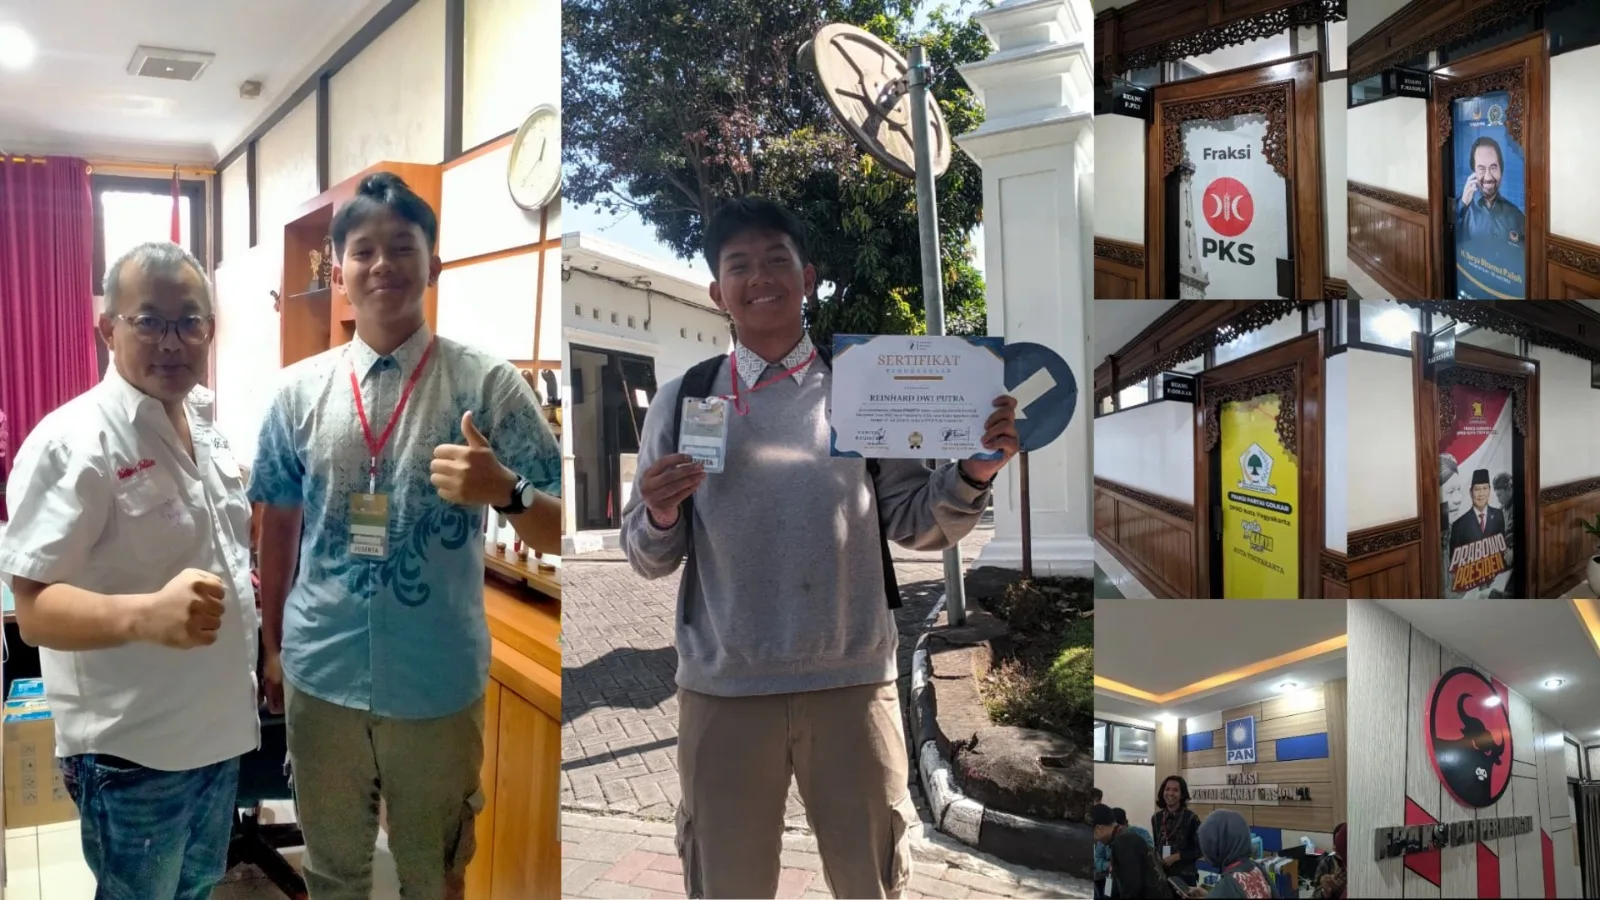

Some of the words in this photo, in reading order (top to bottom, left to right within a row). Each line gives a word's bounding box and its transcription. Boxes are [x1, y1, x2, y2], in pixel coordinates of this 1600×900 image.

[1203, 145, 1251, 160] Fraksi
[1202, 237, 1256, 266] PKS
[877, 354, 961, 366] SERTIFIKAT
[869, 394, 915, 402] REINHARD
[1265, 502, 1290, 512] GOLKAR
[1449, 533, 1507, 572] PRABOWO
[1452, 552, 1505, 592] PRESIDEN
[1228, 749, 1254, 761] PAN
